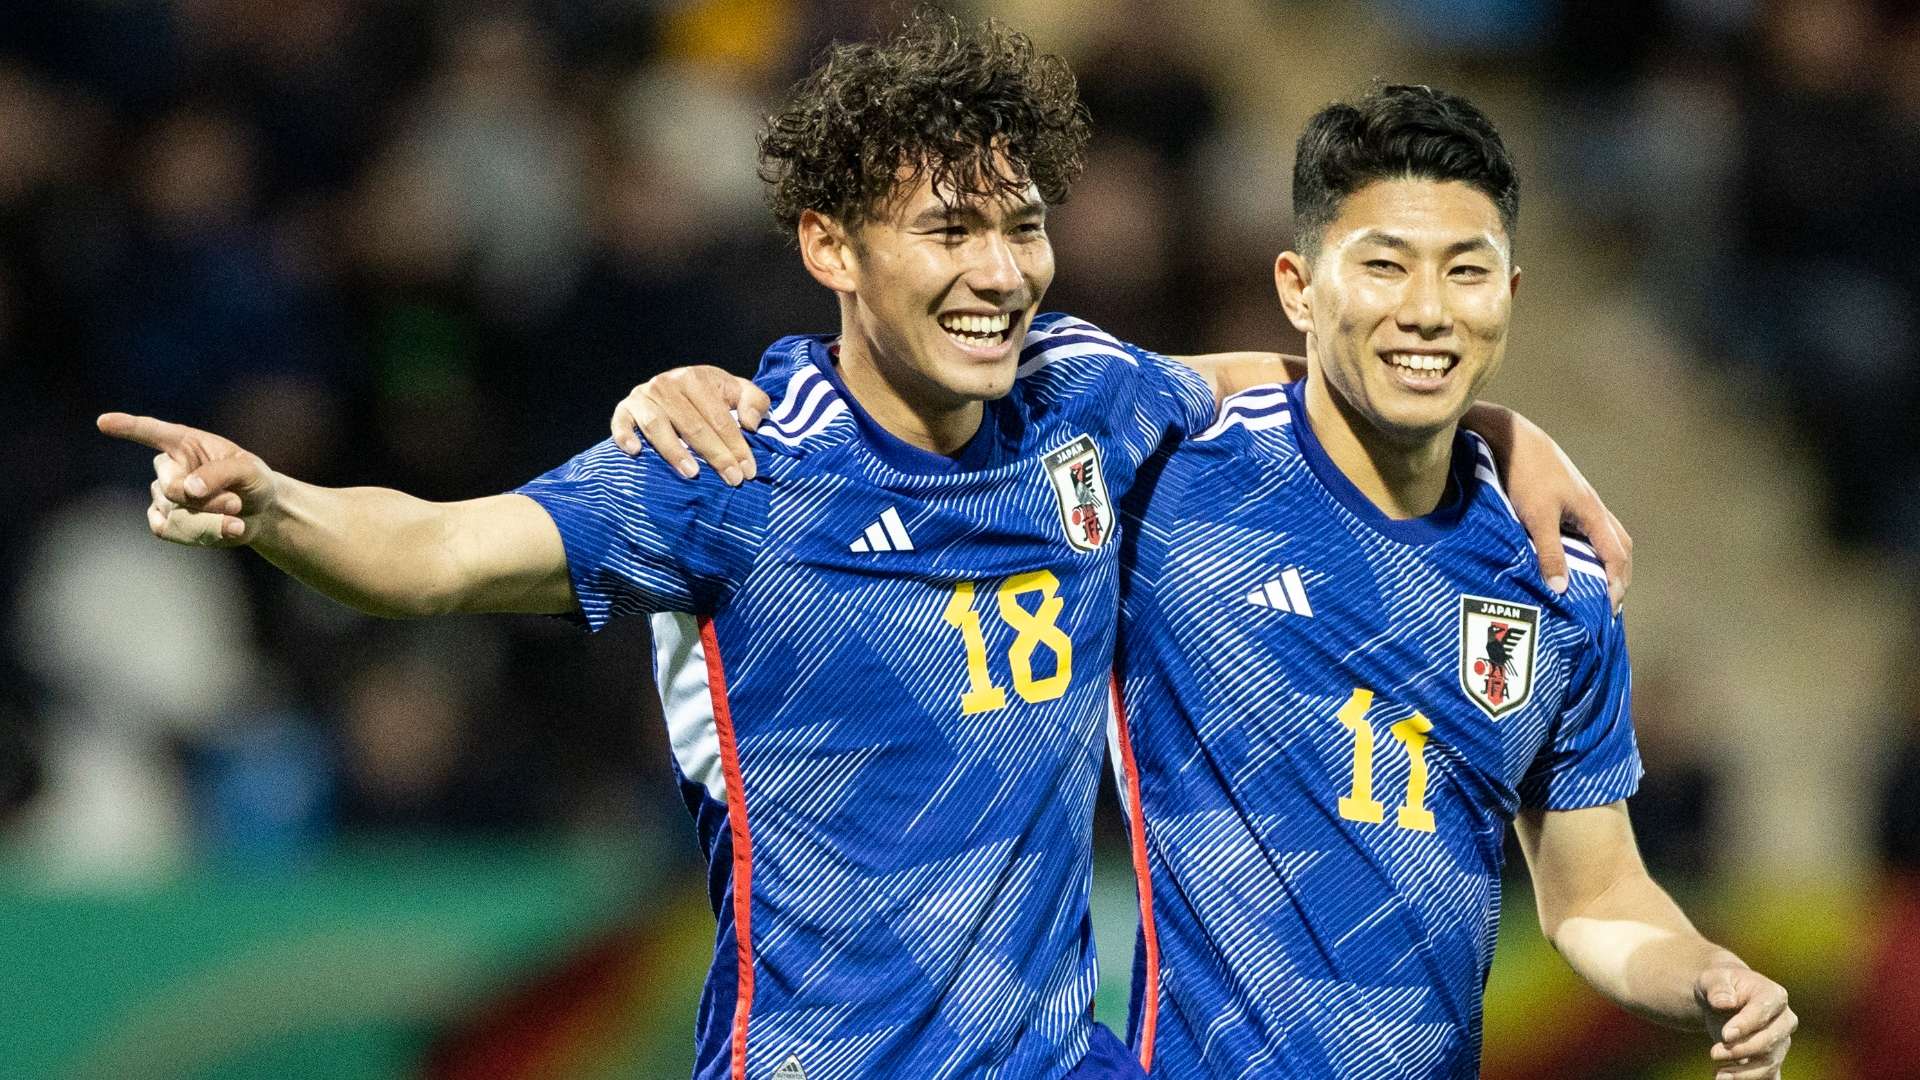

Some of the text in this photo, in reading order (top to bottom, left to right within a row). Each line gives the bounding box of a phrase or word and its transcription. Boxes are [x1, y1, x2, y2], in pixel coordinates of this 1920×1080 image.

[1056, 442, 1085, 464] JAPAN
[1480, 603, 1521, 619] JAPAN
[942, 569, 1072, 716] 18
[1480, 679, 1510, 700] JFA
[1336, 687, 1436, 833] 11
